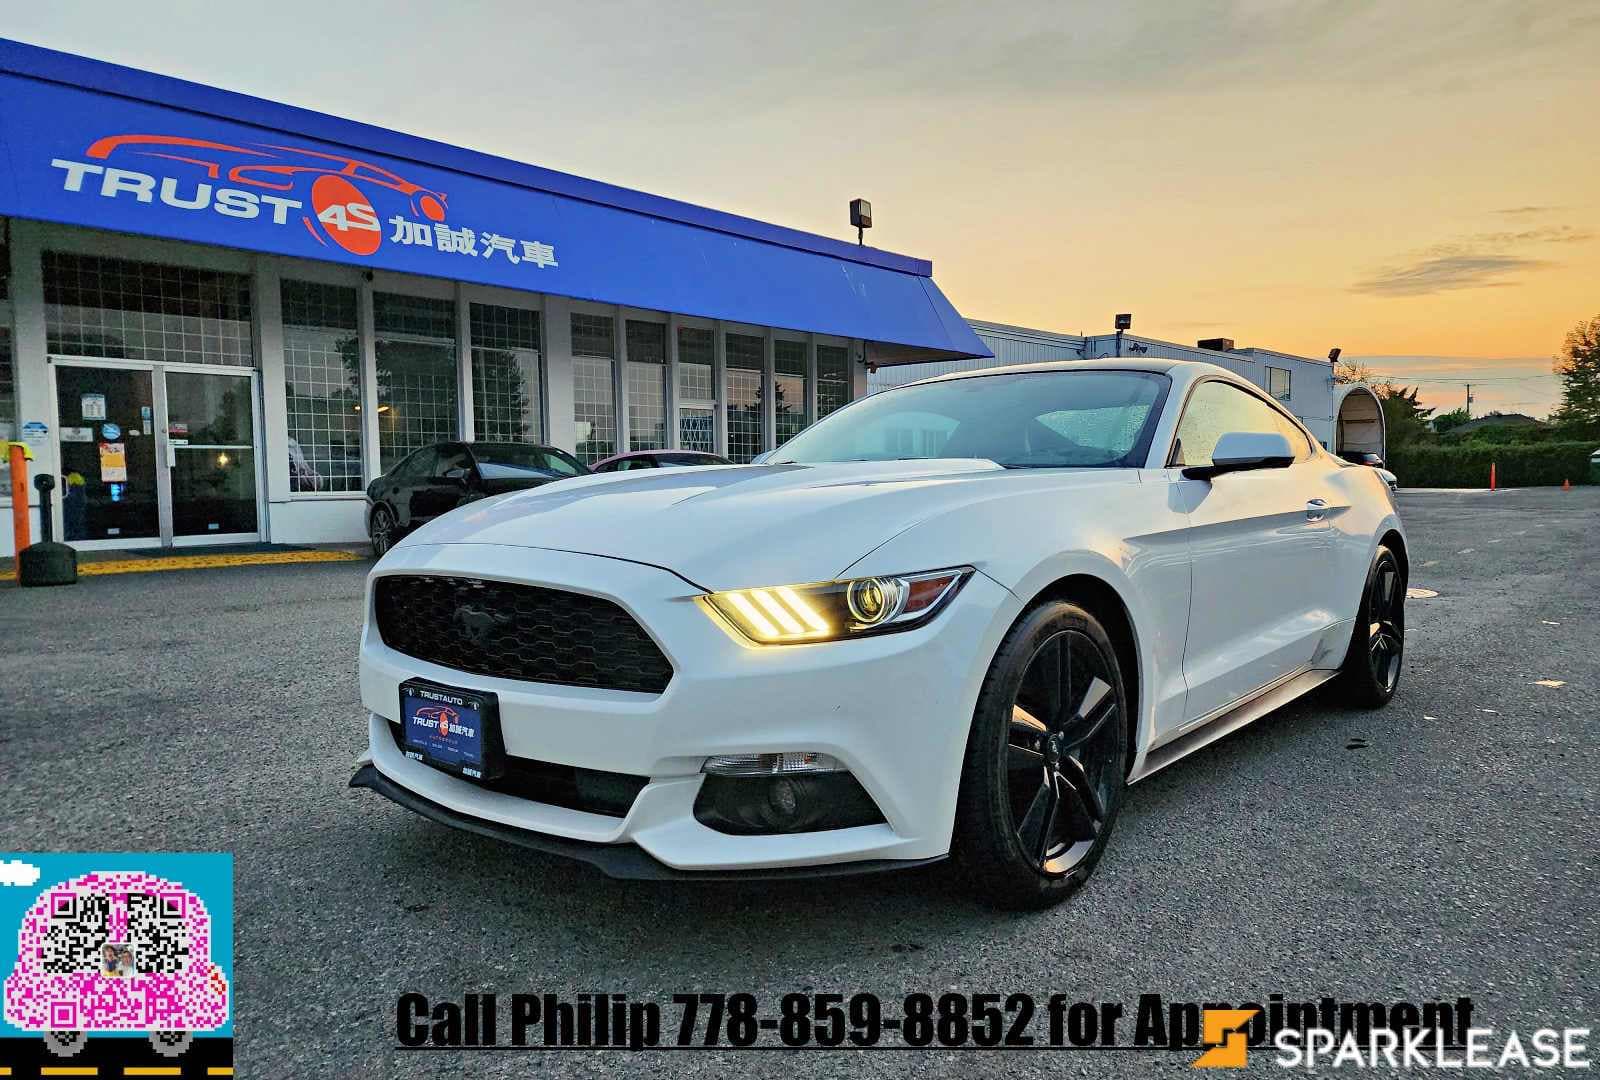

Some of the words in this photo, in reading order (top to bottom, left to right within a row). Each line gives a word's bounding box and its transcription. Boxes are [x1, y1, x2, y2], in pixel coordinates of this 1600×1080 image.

[51, 158, 303, 225] TRUST
[317, 202, 381, 231] 4S
[388, 215, 559, 269] 加誠汽車
[420, 690, 463, 705] TRUSTAUTO
[412, 716, 439, 729] TRUST
